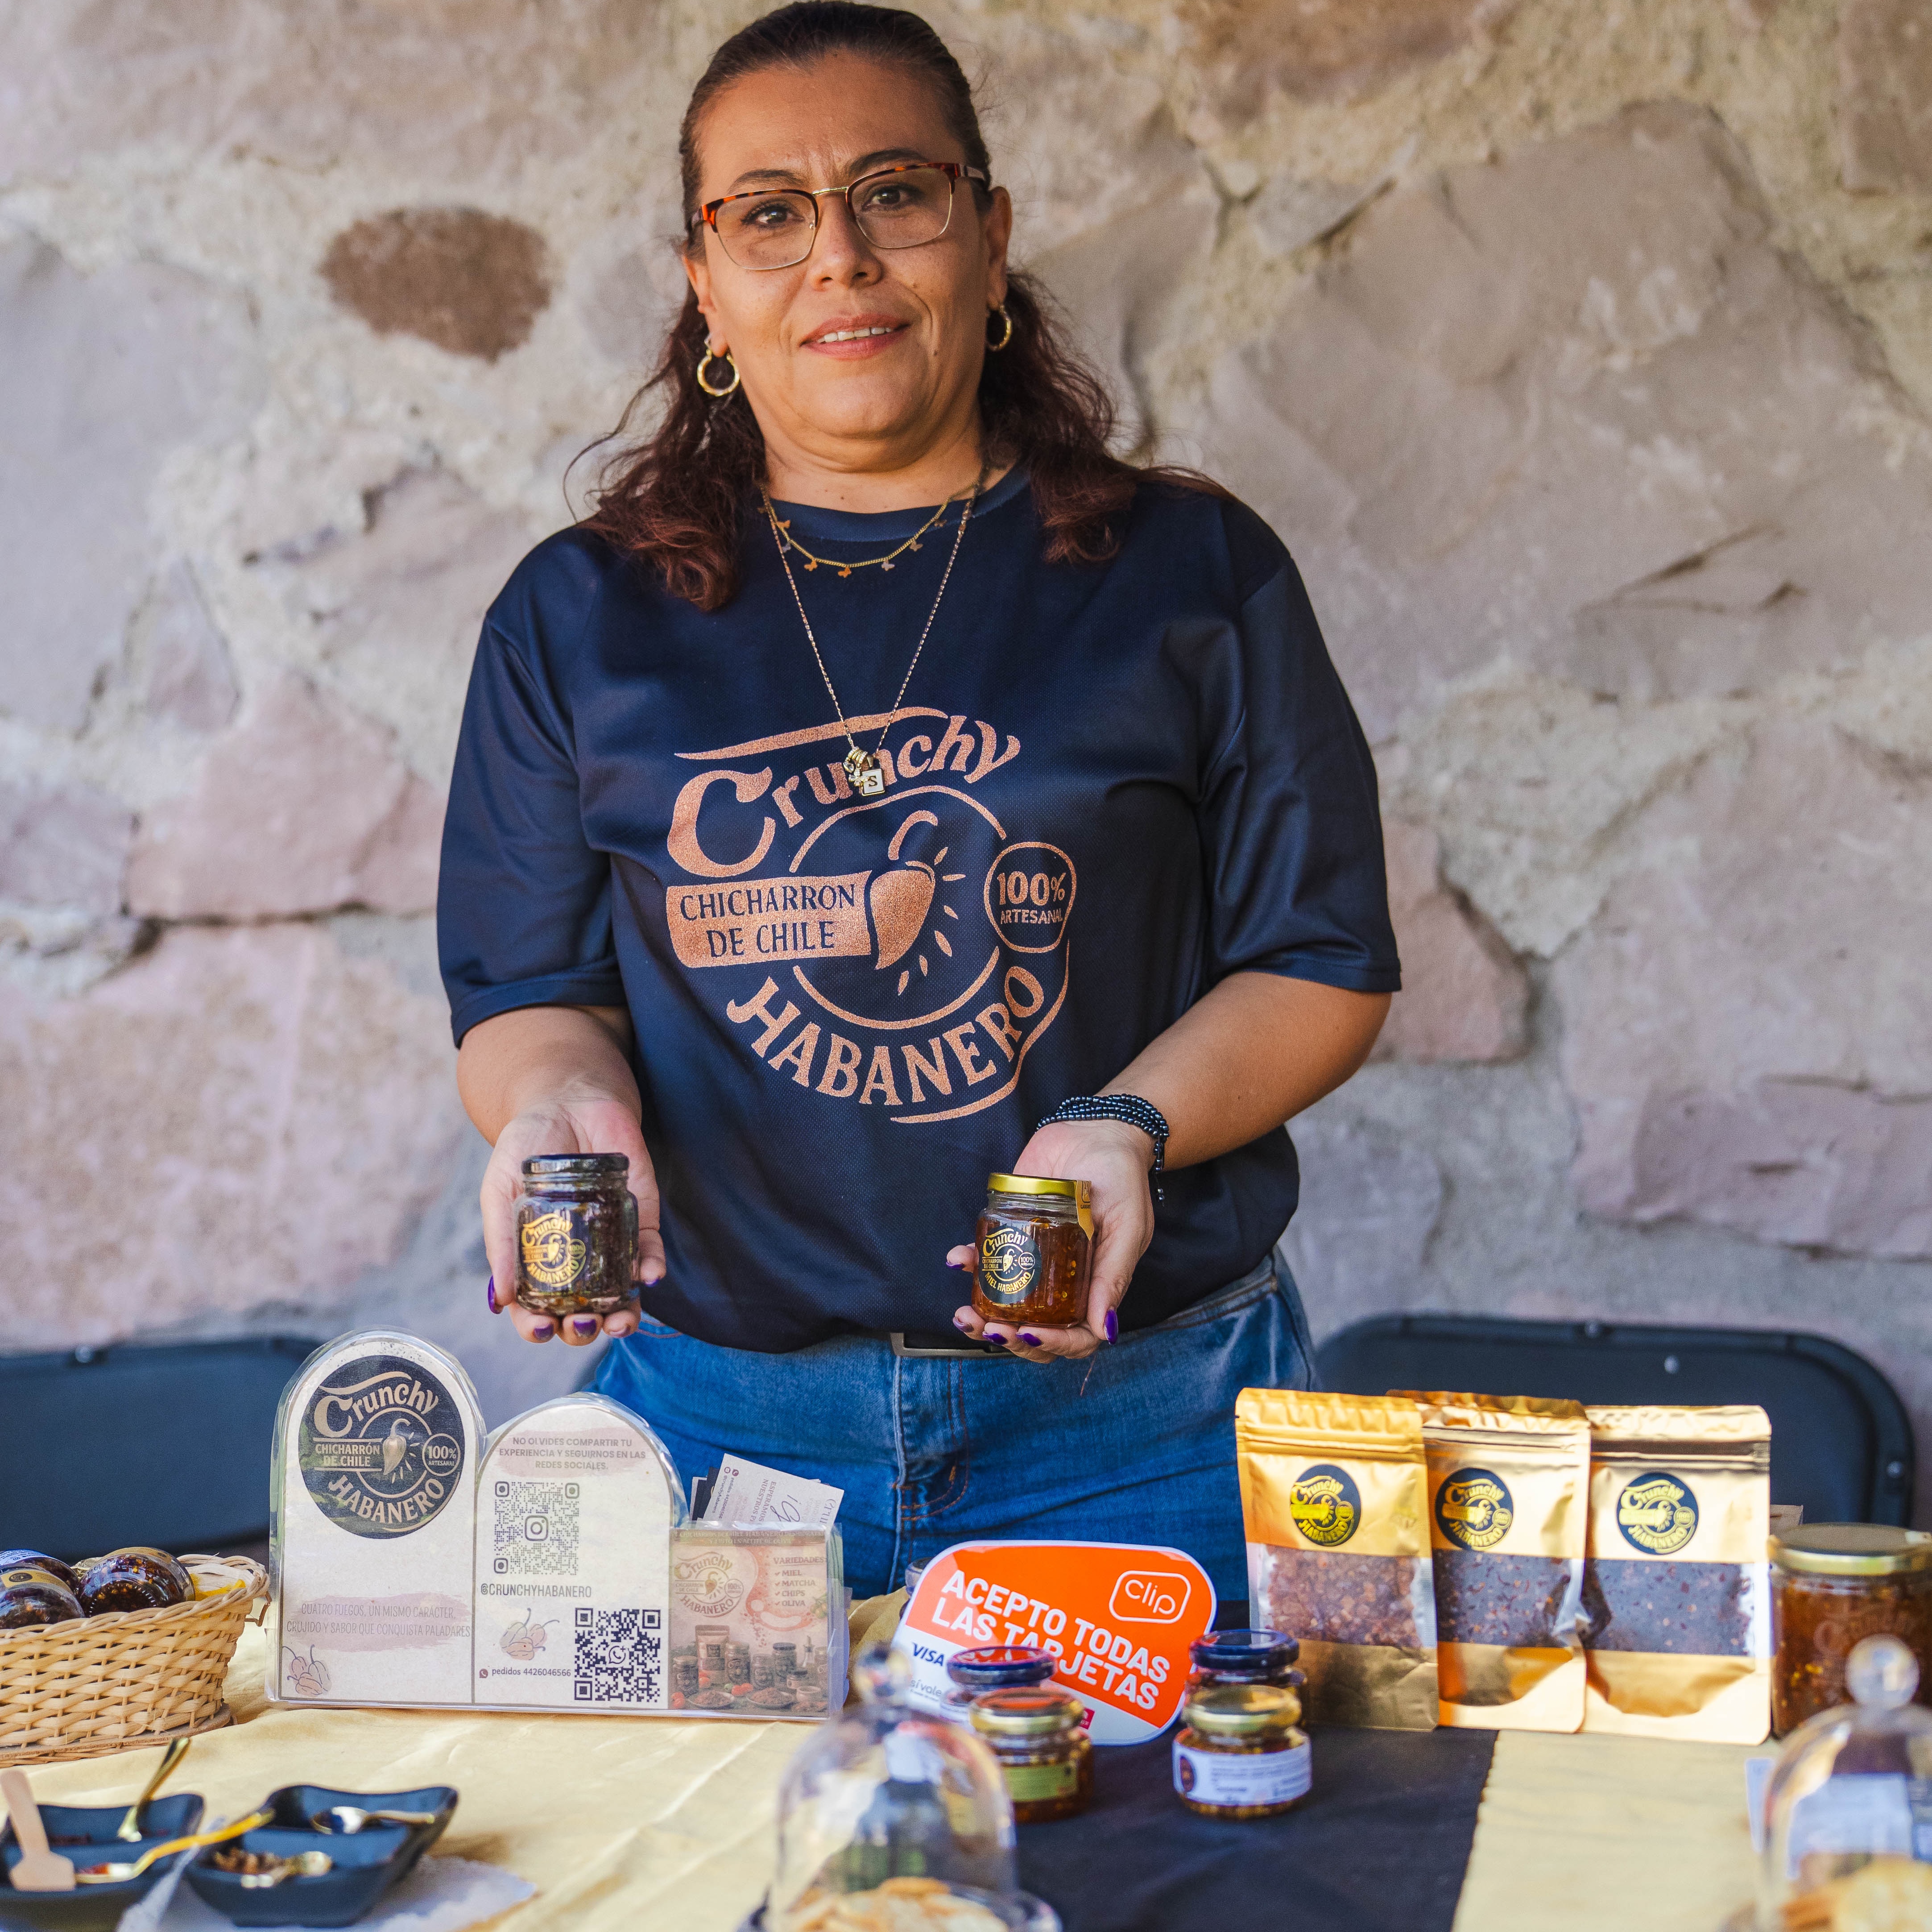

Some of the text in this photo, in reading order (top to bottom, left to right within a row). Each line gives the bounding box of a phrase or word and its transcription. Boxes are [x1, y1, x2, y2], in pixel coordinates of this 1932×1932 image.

[667, 707, 1021, 877] Crunchy
[868, 775, 878, 787] S
[997, 871, 1066, 906] 100%
[679, 884, 855, 921] CHICHARRON
[1000, 908, 1063, 924] ARTESANAL
[706, 920, 835, 958] DE CHILE
[726, 964, 1045, 1105] HABANERO
[521, 1213, 573, 1247] Crunchy
[983, 1228, 1028, 1257] Crunchy
[527, 1259, 579, 1283] HABANERO
[985, 1271, 1031, 1292] MIEL HABANERO
[314, 1371, 439, 1438] Crunchy
[315, 1442, 380, 1455] CHICHARRÓN
[427, 1445, 457, 1460] 100%
[499, 1448, 555, 1457] EXPERIENCIA
[565, 1450, 615, 1458] SEGUIRNOS
[528, 1437, 564, 1445] OLVIDES
[567, 1438, 619, 1447] COMPARTIR
[323, 1455, 371, 1467] DE CHILE
[535, 1460, 608, 1470] REDES SOCIALES.
[328, 1474, 444, 1524] HABANERO
[753, 1478, 768, 1515] NUESTROS
[759, 1481, 777, 1522] ESPERAMOS
[1291, 1475, 1344, 1505] Crunchy
[1444, 1478, 1505, 1504] Crunchy
[1621, 1479, 1685, 1510] Crunchy
[1298, 1519, 1348, 1543] HABANERO
[1449, 1521, 1504, 1547] HABANERO
[1628, 1524, 1688, 1550] HABANERO
[674, 1551, 733, 1580] Crunchy
[480, 1583, 592, 1598] @CRUNCHYHABANERO
[1125, 1579, 1176, 1614] clip
[301, 1603, 333, 1615] CUATRO
[335, 1604, 366, 1617] FUEGOS,
[369, 1605, 380, 1617] UN
[383, 1605, 411, 1618] MISMO
[678, 1594, 734, 1614] HABANERO
[287, 1621, 471, 1637] CRUJIDO Y SABOR QUE CONQUISTA PALADARES
[941, 1569, 1171, 1684] ACEPTO TODAS
[912, 1642, 945, 1667] VISA
[931, 1597, 1159, 1710] LAS TARJETAS
[492, 1667, 571, 1677] pedidos 4426046566
[921, 1685, 942, 1697] vale
